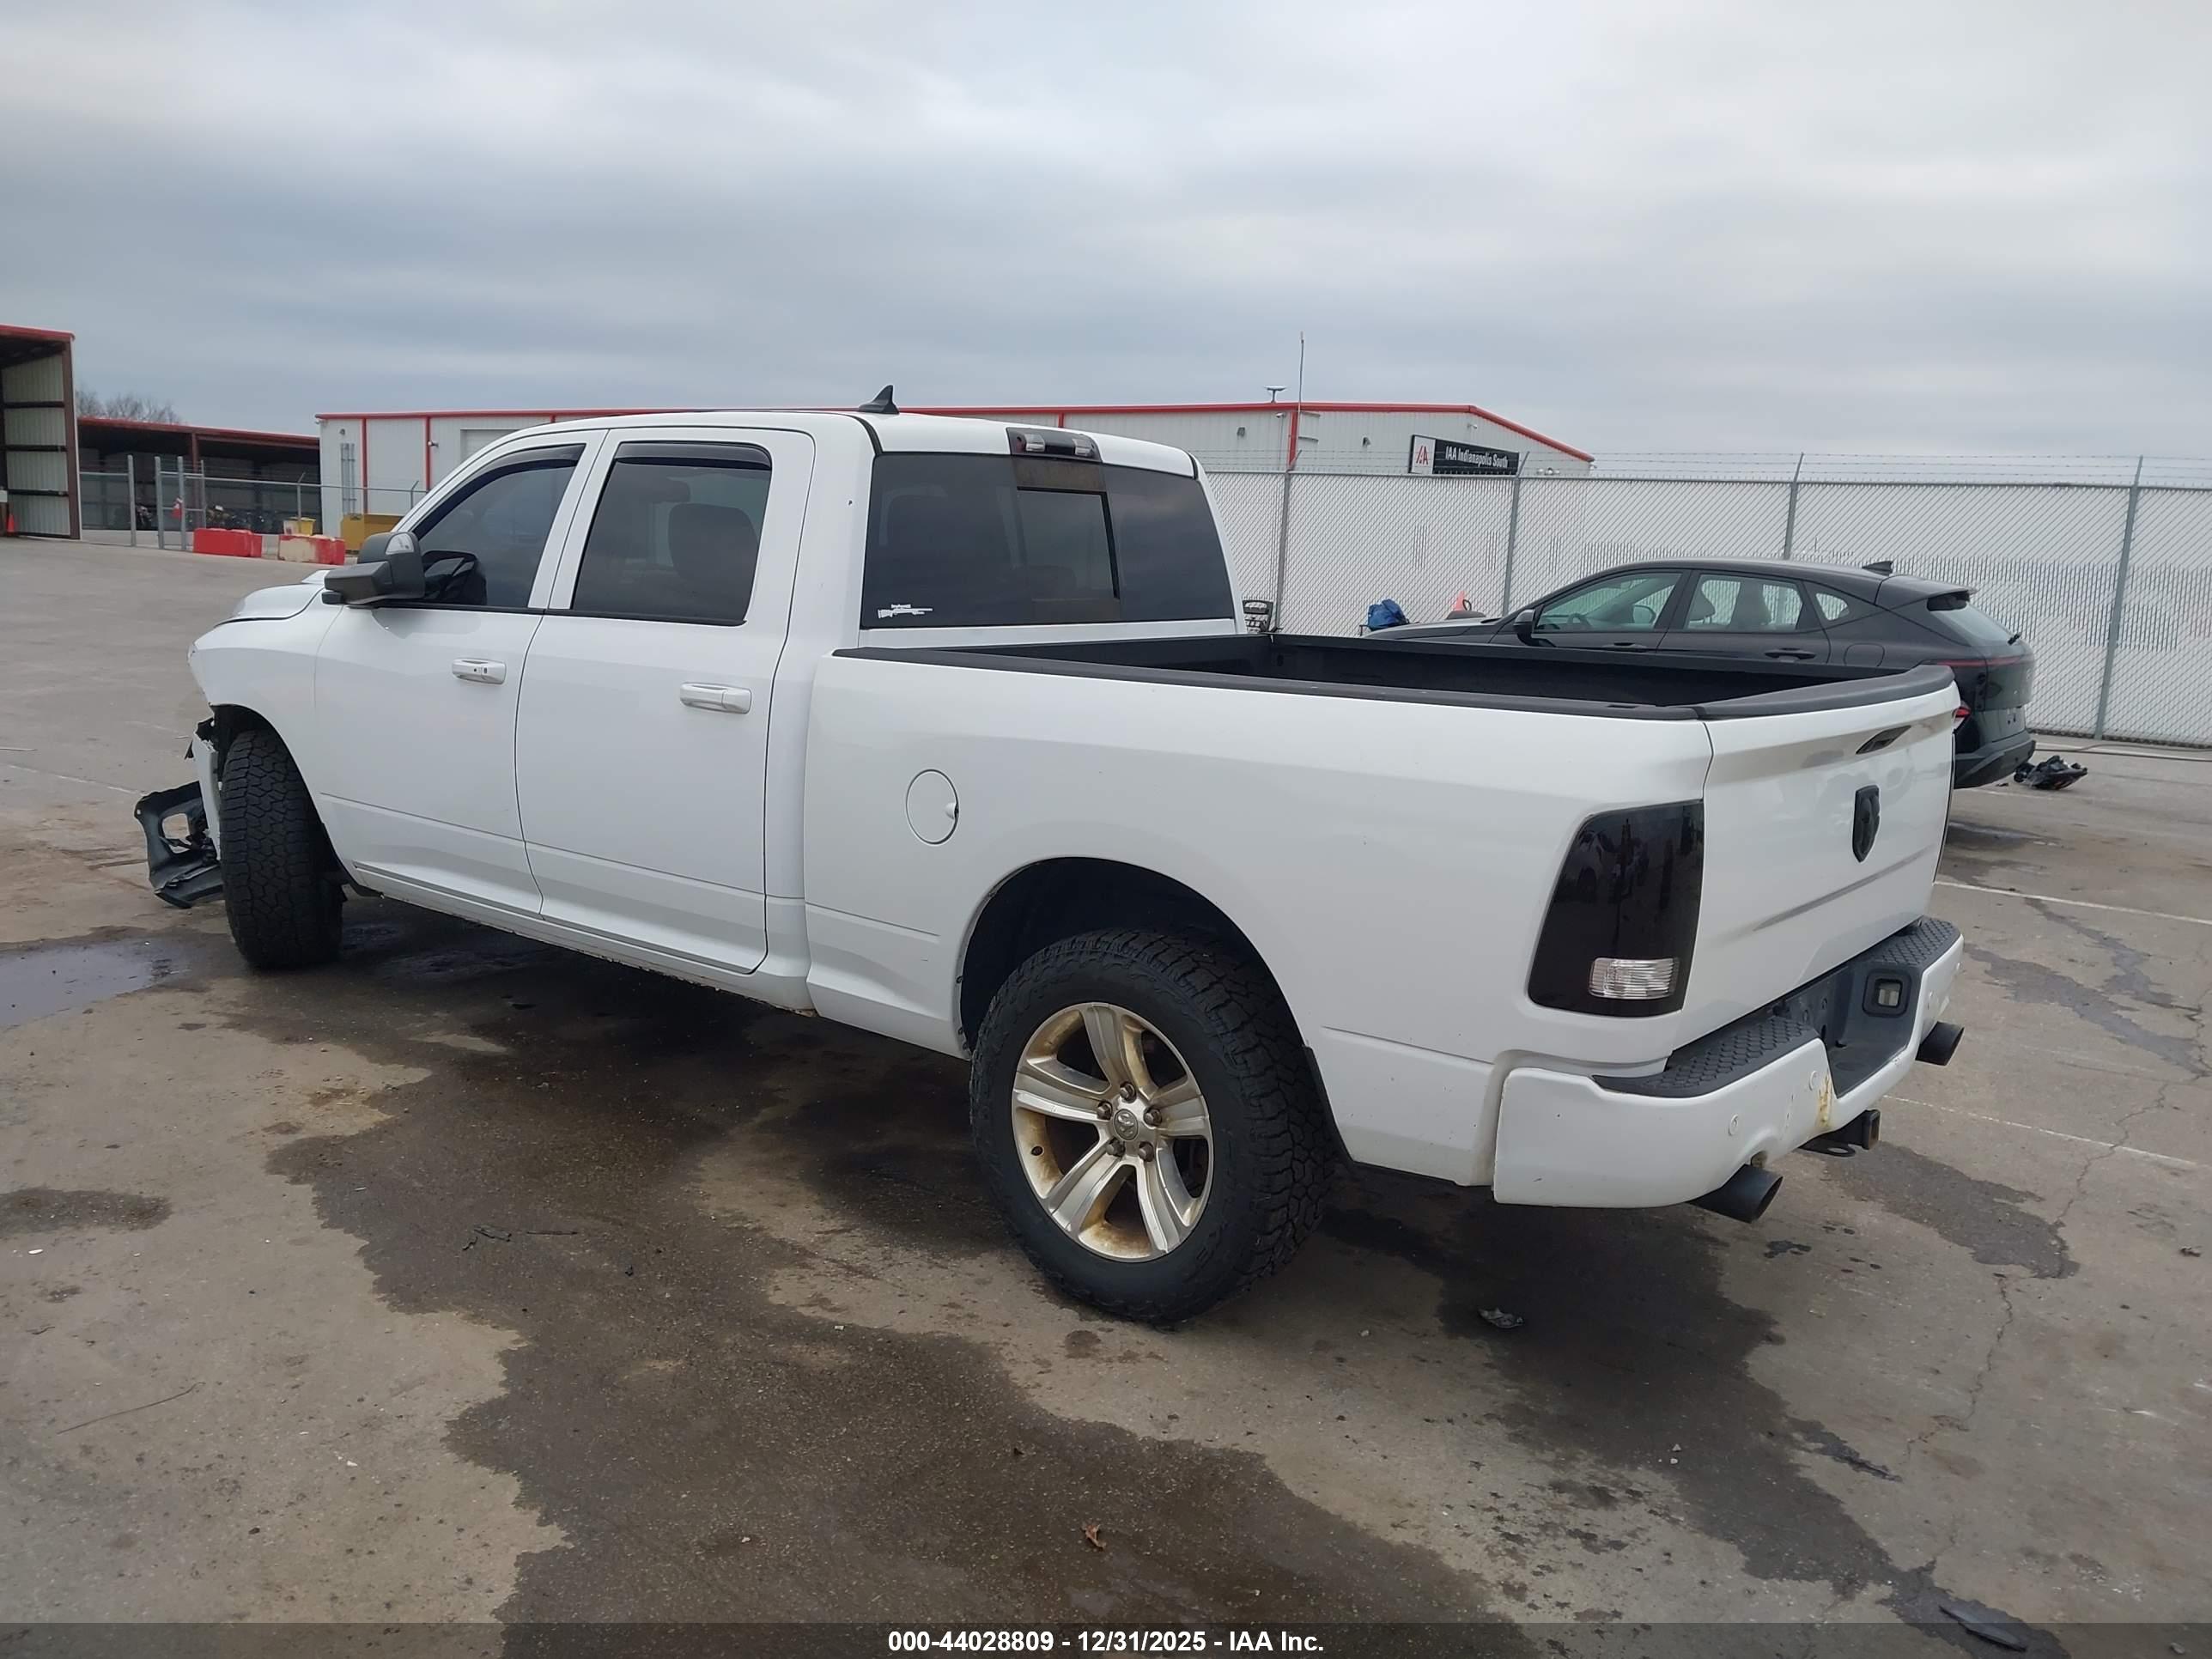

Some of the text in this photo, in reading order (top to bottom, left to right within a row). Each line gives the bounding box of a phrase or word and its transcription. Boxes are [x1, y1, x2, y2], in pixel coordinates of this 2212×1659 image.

[1445, 445, 1509, 468] IAA Indianapolis South
